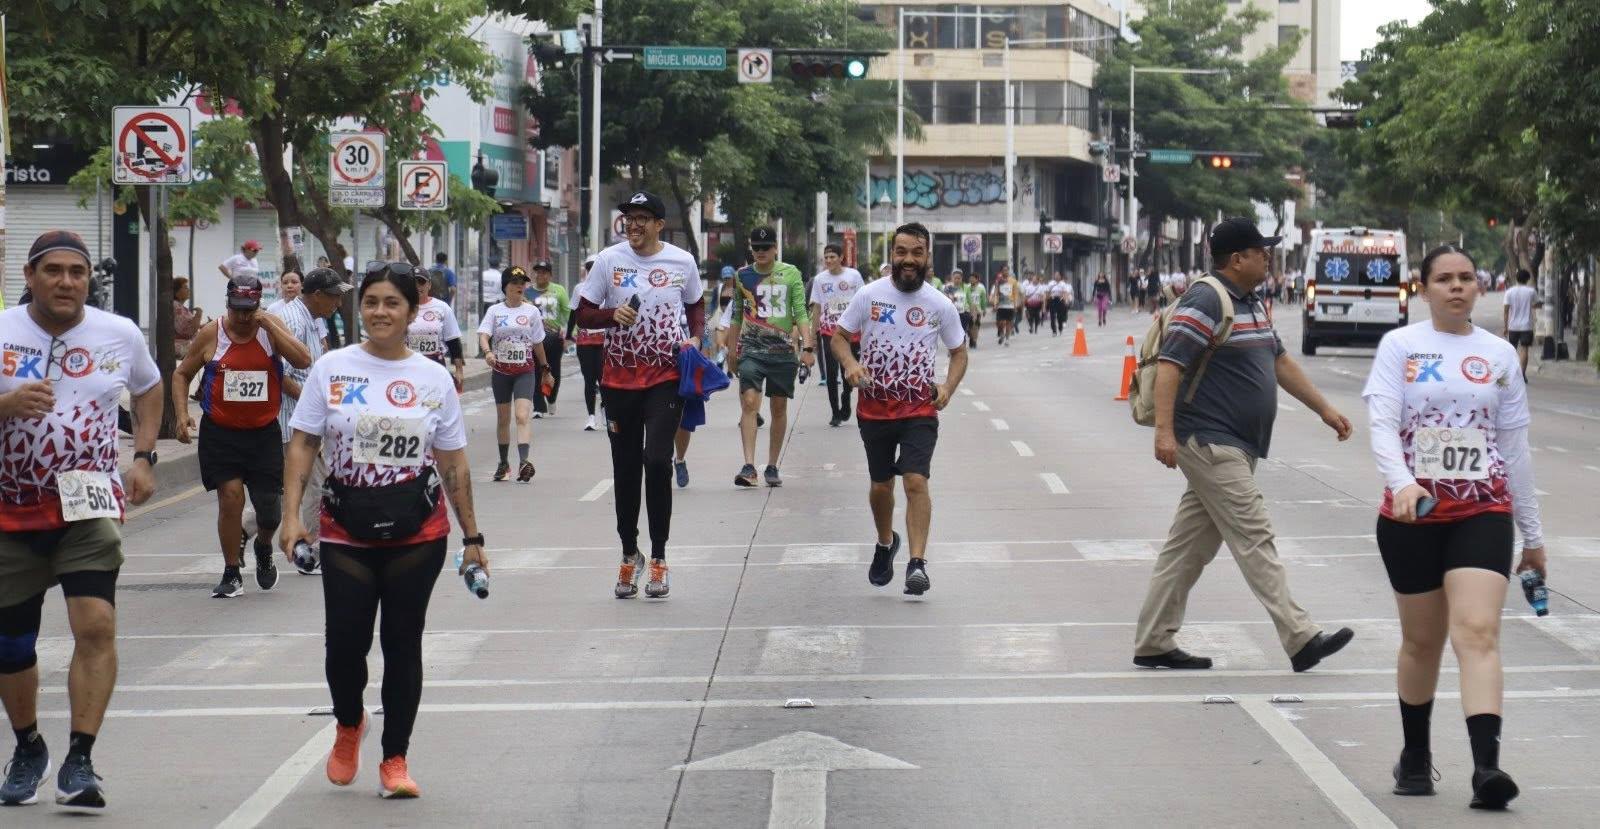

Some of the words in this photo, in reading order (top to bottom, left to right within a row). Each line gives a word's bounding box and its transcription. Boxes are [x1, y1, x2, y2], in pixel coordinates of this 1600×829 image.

[647, 54, 680, 65] MIGUEL
[683, 55, 723, 66] HIDALGO
[345, 144, 369, 165] 30
[415, 172, 430, 198] E
[1322, 245, 1396, 255] AMBULANCIA
[613, 266, 638, 274] CARRERA
[613, 272, 638, 288] 5K
[757, 284, 788, 318] 33
[871, 300, 897, 310] CARRERA
[871, 306, 897, 325] 5K
[3, 342, 42, 357] CARRERA
[419, 341, 437, 352] 623
[2, 349, 44, 378] 5K
[507, 350, 524, 361] 260
[329, 375, 369, 385] CARRERA
[239, 381, 264, 397] 327
[329, 383, 368, 405] 5K
[378, 434, 420, 459] 282
[1442, 446, 1481, 472] 072
[86, 484, 118, 511] 562
